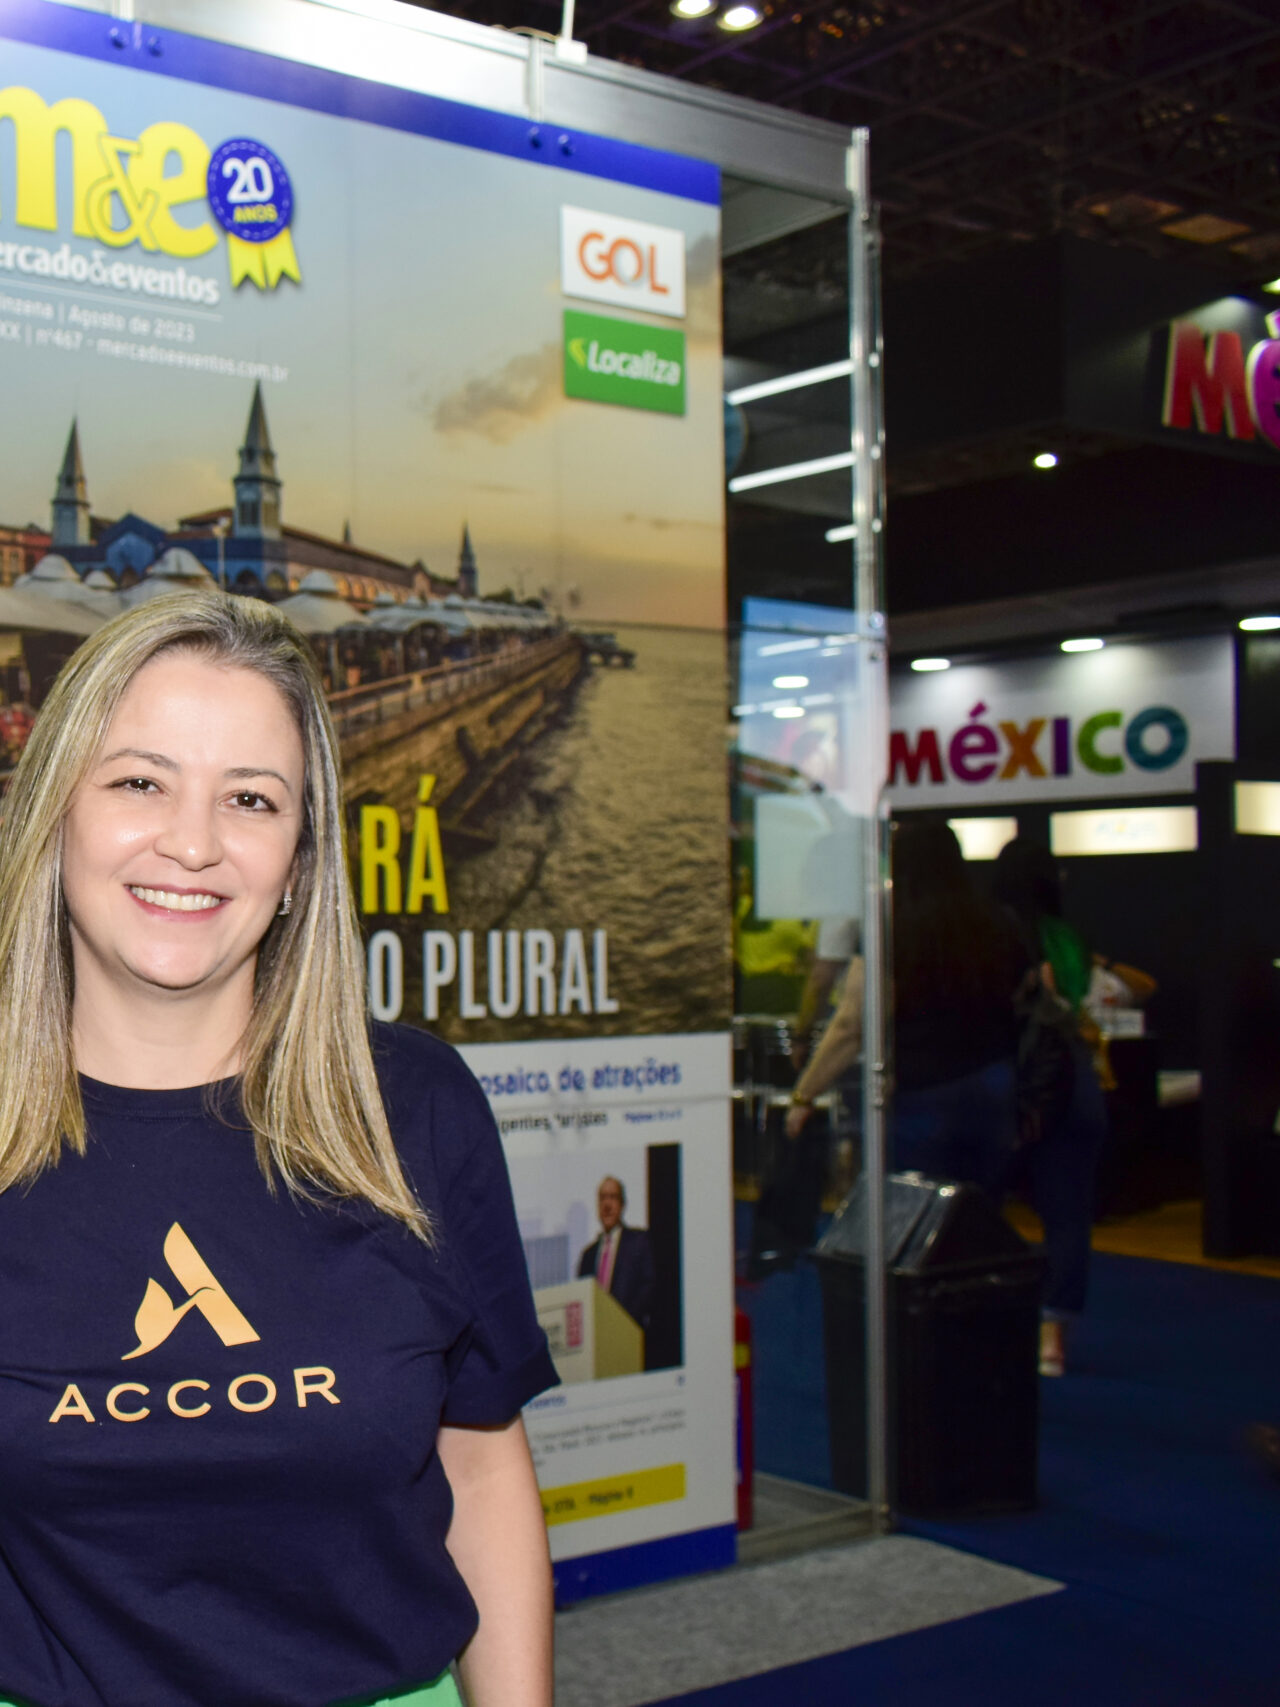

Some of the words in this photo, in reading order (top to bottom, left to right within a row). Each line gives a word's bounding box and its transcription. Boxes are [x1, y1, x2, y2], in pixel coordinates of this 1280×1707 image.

[222, 156, 275, 205] 20
[233, 203, 278, 224] ANOS
[578, 231, 669, 295] GOL
[588, 340, 681, 387] Localiza
[423, 928, 620, 1021] PLURAL
[558, 1065, 585, 1092] de
[592, 1057, 682, 1092] atrações
[48, 1365, 341, 1423] ACCOR
